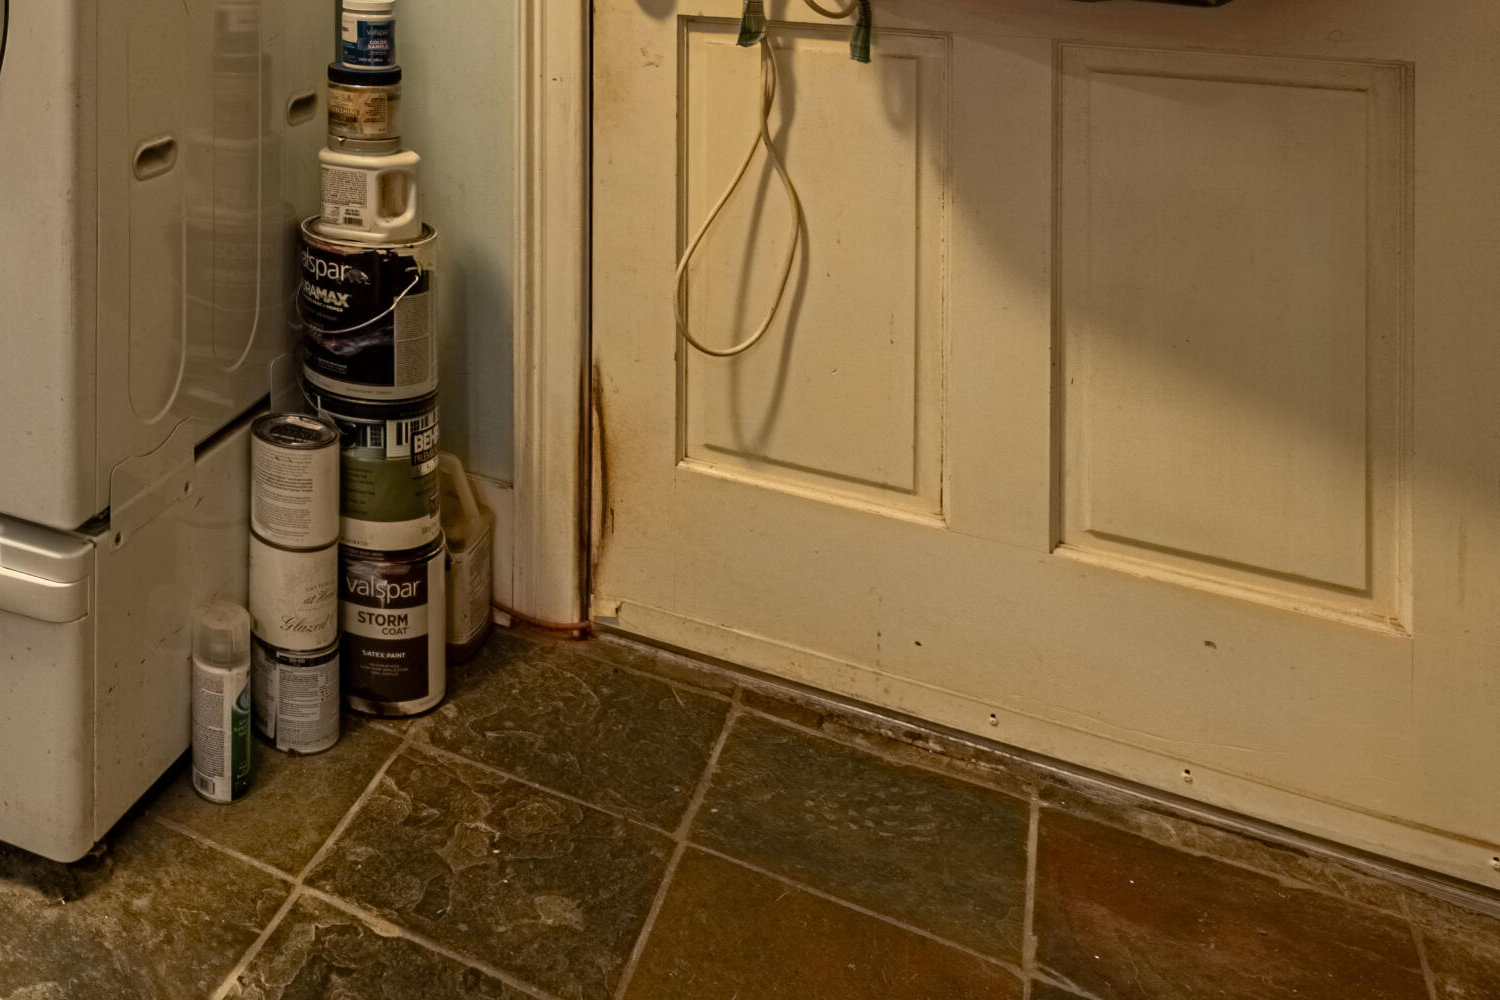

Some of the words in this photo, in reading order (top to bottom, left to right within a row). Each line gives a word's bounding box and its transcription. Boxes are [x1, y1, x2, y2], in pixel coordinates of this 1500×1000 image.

[301, 247, 349, 281] alspar
[303, 281, 349, 308] RAMAX
[413, 424, 439, 454] BEH
[346, 575, 420, 604] valspar
[357, 611, 408, 627] STORM
[381, 626, 408, 636] COAT
[362, 649, 385, 658] LATEX
